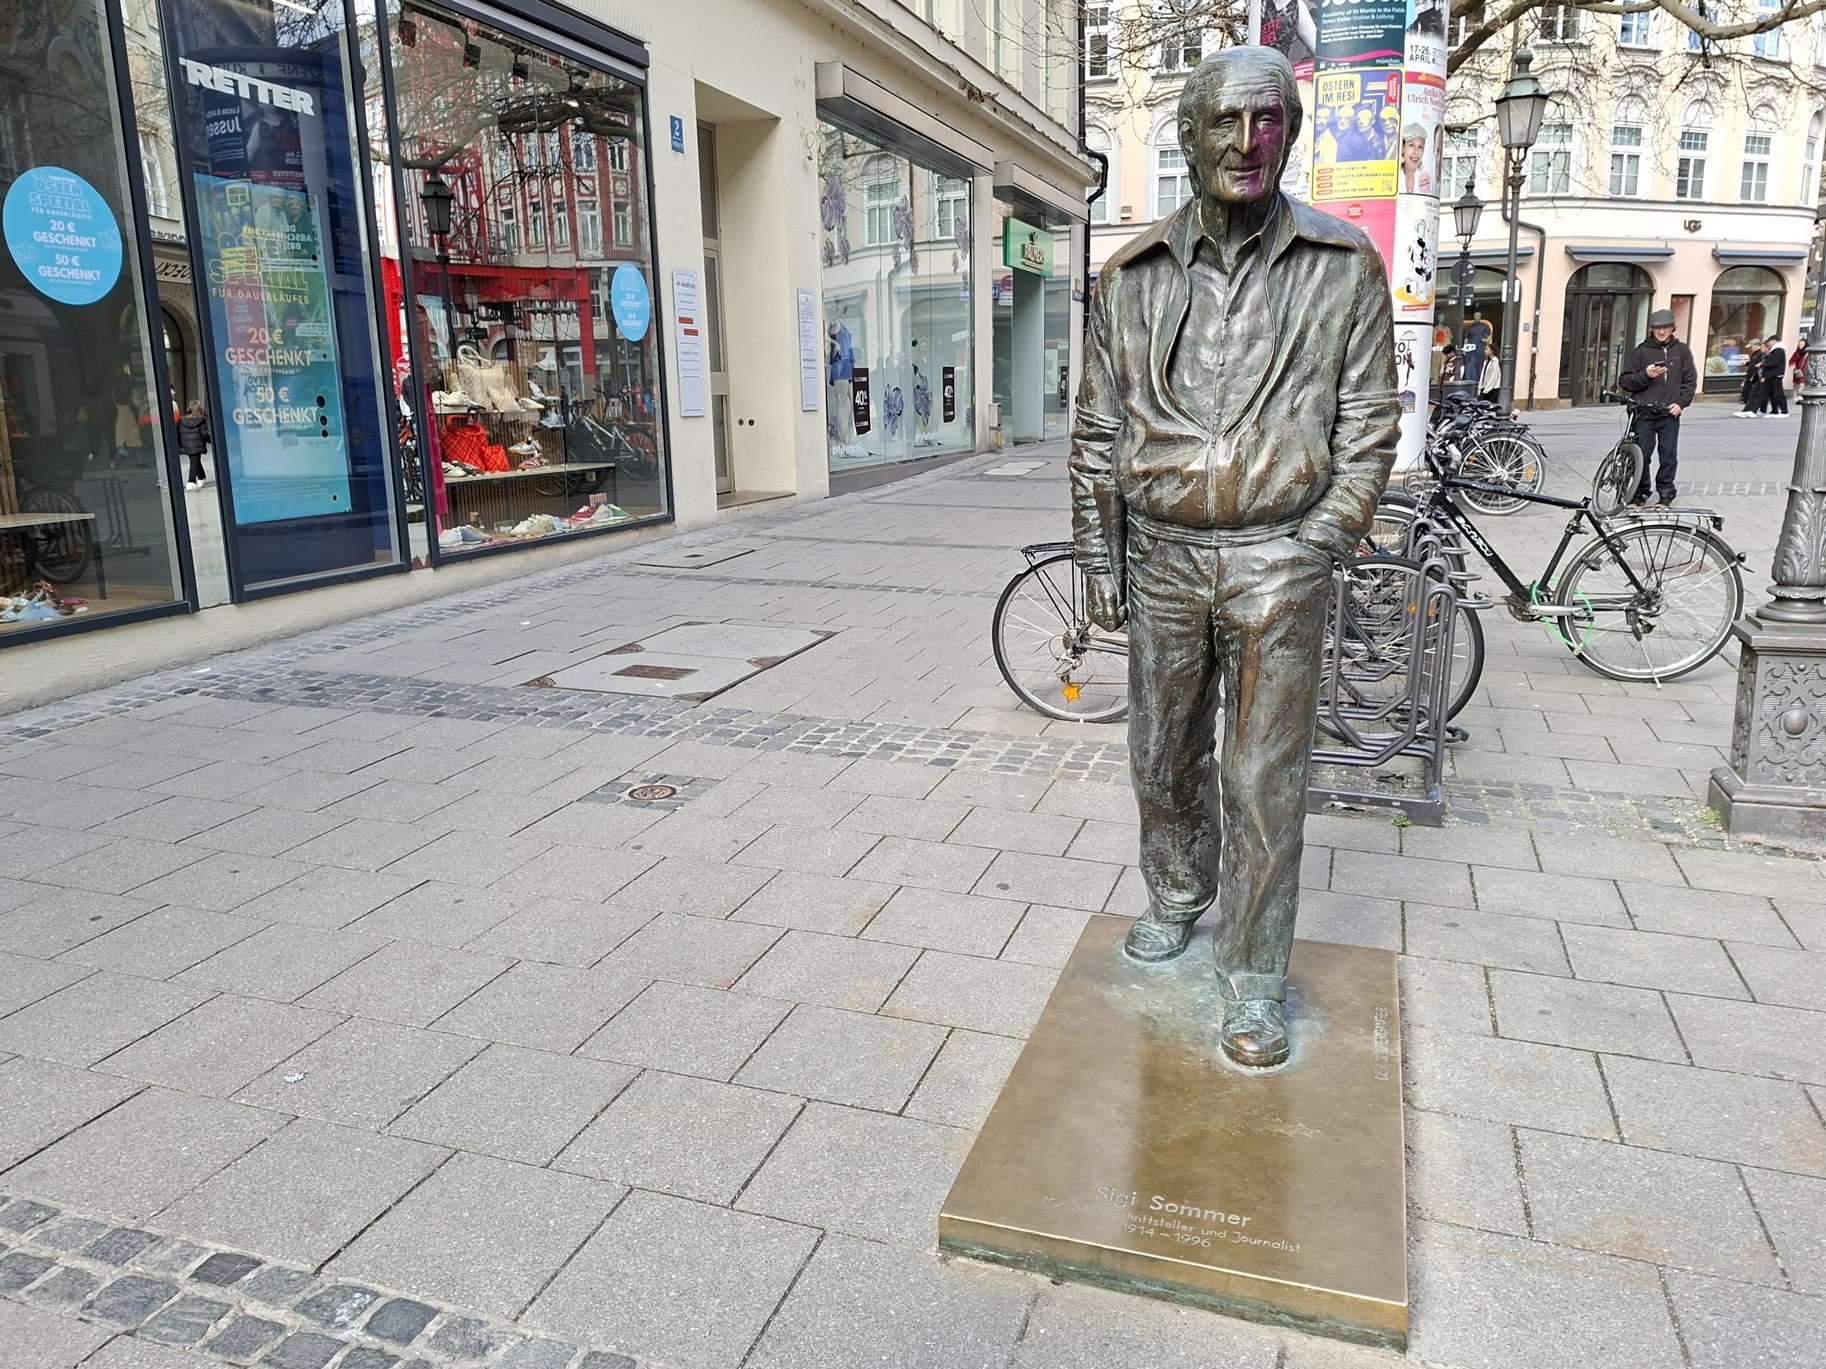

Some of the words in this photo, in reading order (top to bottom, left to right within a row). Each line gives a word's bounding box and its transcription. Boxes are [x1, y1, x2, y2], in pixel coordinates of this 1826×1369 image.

[1409, 54, 1431, 64] APRIL
[1322, 79, 1355, 92] OSTERN
[1322, 93, 1333, 104] IM
[1335, 91, 1355, 102] RESI
[674, 119, 680, 136] 2
[49, 219, 65, 231] 20
[67, 221, 77, 233] €
[1684, 219, 1702, 233] UGG
[33, 230, 97, 249] GESCHENKT
[55, 253, 70, 266] 50
[70, 255, 81, 267] €
[38, 265, 101, 282] GESCHENKT
[212, 285, 233, 299] FÜR
[237, 287, 310, 305] DAUERLÄUFER
[248, 326, 268, 344] 20
[271, 327, 284, 345] €
[225, 346, 313, 367] GESCHENKT
[256, 386, 275, 403] 50
[277, 386, 291, 403] €
[232, 406, 318, 426] GESCHENKT
[1094, 1185, 1137, 1209] Sigi
[1149, 1195, 1252, 1228] Sommer
[1122, 1222, 1154, 1237] 1914
[1175, 1231, 1212, 1249] 1996
[1201, 1227, 1228, 1239] und
[1232, 1230, 1301, 1254] Journalist
